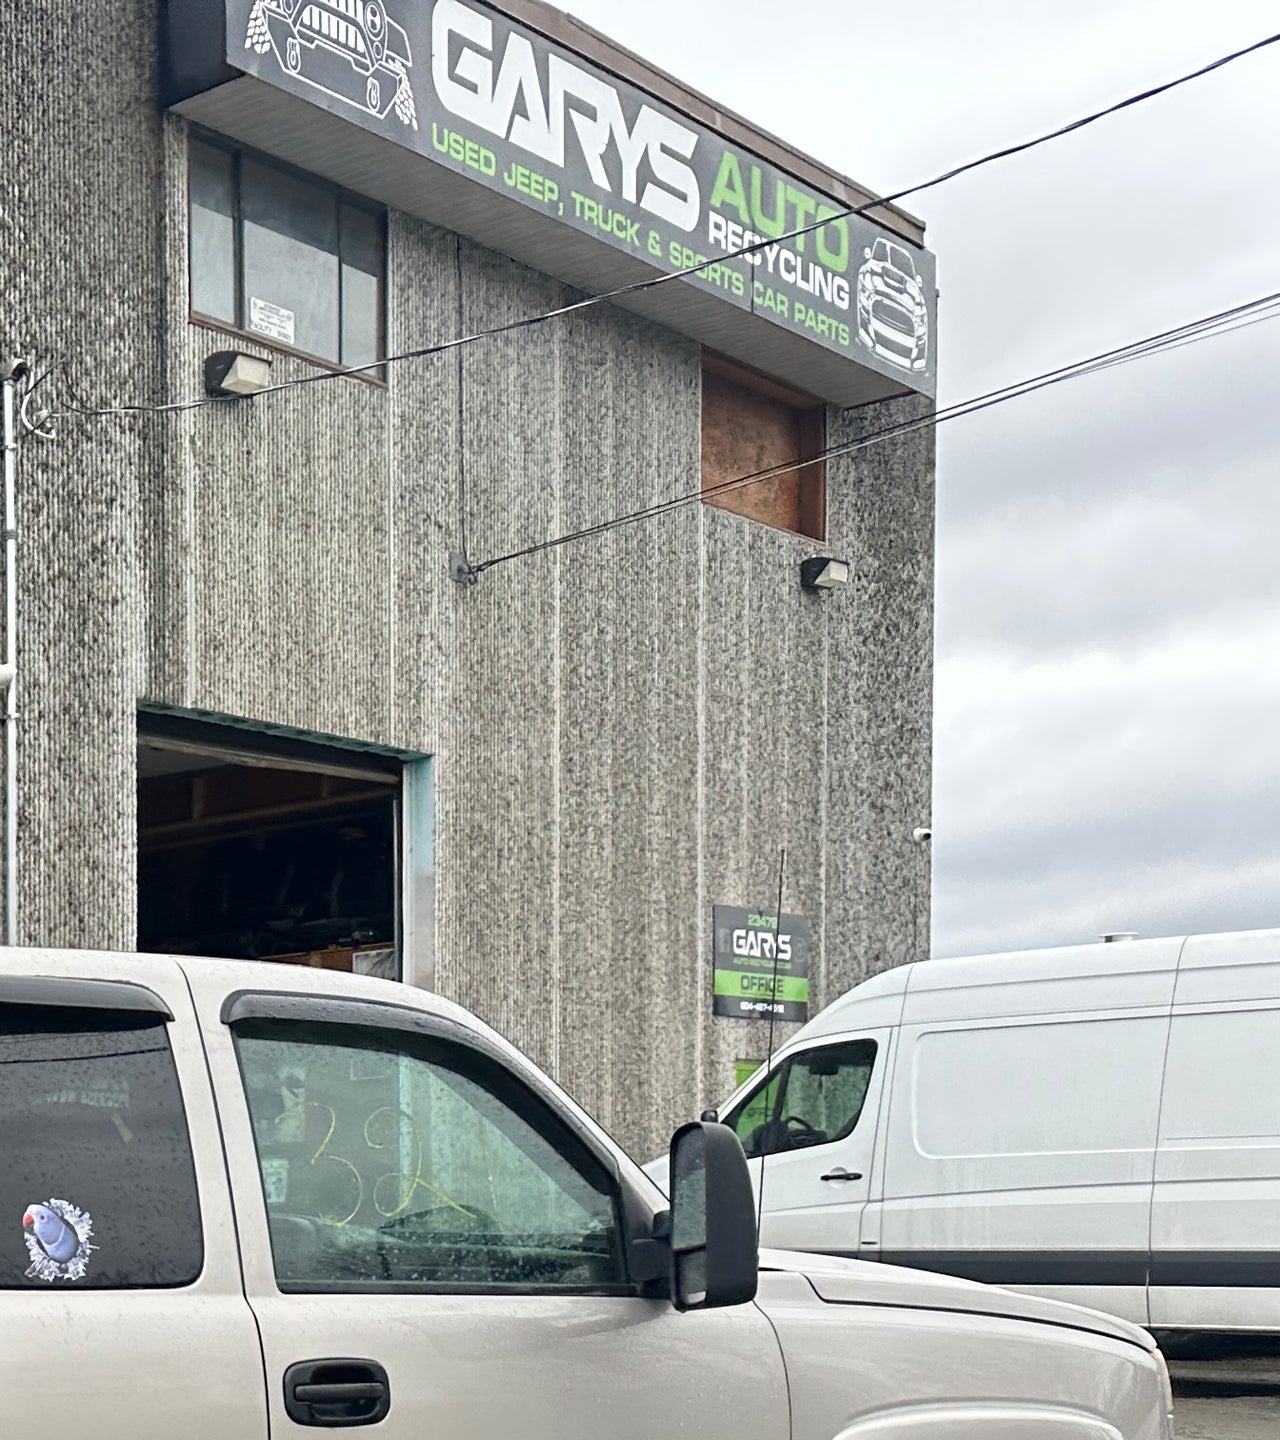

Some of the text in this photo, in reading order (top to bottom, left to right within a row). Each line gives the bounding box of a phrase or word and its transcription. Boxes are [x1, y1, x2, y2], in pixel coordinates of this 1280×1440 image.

[431, 0, 701, 233] GARYS
[431, 122, 850, 347] USED JEEP, TRUCK & SPORTS CAR PARTS
[707, 210, 850, 311] RECYCLING
[709, 150, 850, 273] AUTO
[740, 974, 784, 994] OFFICE
